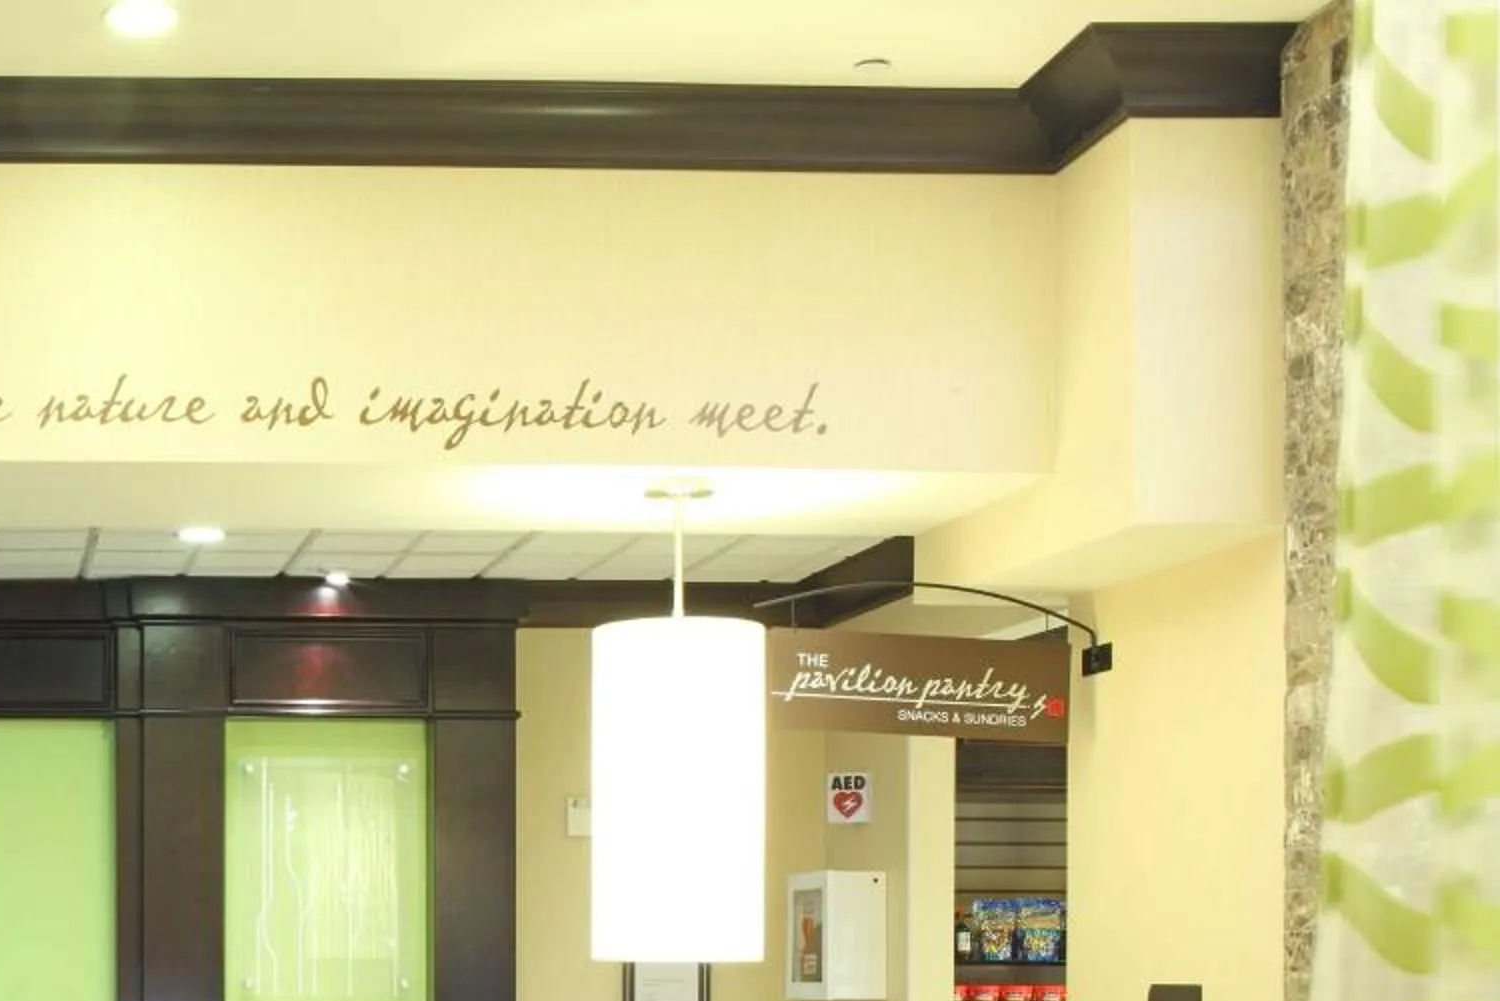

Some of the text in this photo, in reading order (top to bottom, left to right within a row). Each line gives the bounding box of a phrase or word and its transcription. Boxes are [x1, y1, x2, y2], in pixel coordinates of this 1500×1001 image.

[35, 372, 217, 430] nature
[239, 375, 335, 432] and
[358, 377, 668, 452] imagination
[686, 381, 829, 439] meet.
[796, 652, 830, 668] THE
[783, 663, 1031, 715] pavilion pantry
[897, 708, 950, 724] SNACKS
[963, 712, 1028, 728] SUNDRIES
[830, 775, 866, 790] AED
